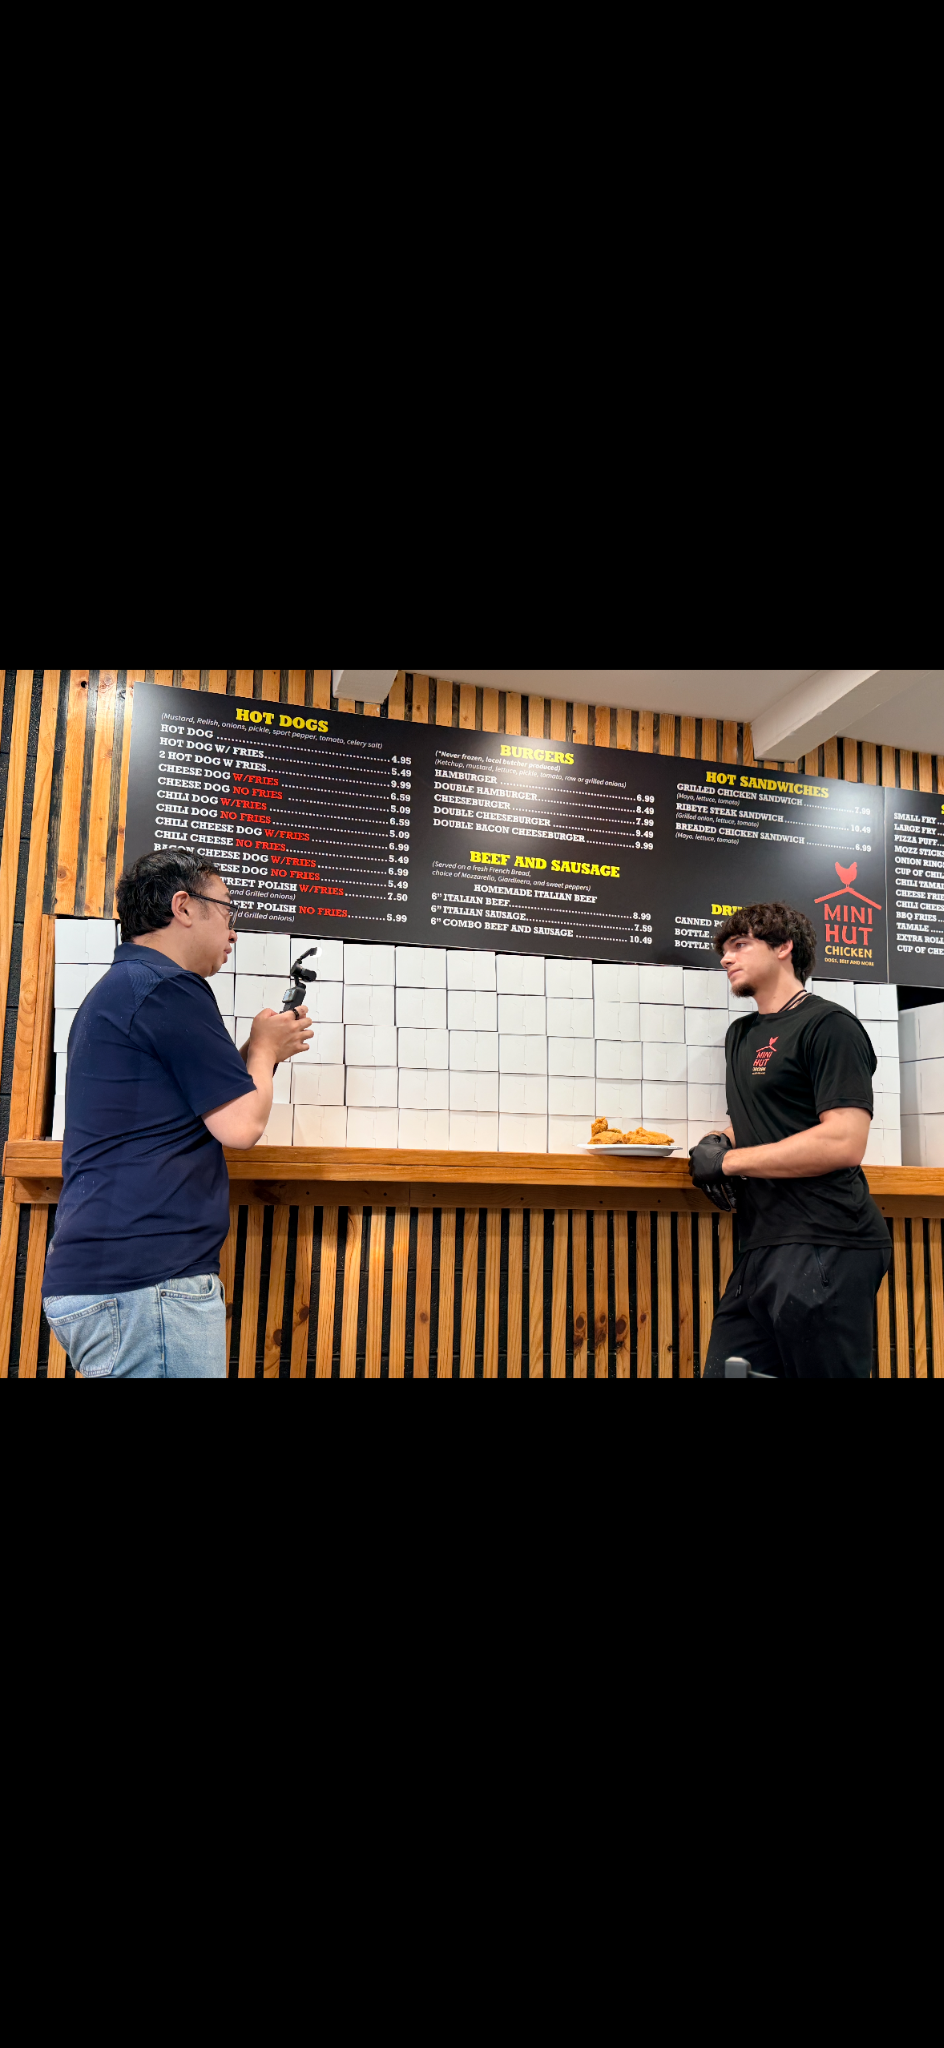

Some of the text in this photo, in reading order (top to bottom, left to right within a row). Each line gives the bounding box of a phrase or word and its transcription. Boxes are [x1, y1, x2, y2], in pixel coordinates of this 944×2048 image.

[162, 713, 195, 724] (Mustard,
[197, 718, 220, 727] Relish,
[222, 722, 246, 731] onions,
[248, 726, 270, 734] pickle,
[292, 732, 317, 740] pepper,
[320, 736, 345, 744] tomato,
[347, 740, 367, 748] celery
[236, 708, 328, 732] HOT DOGS
[161, 724, 411, 764] HOT DOG 4.95
[500, 745, 574, 764] BURGERS
[160, 737, 411, 777] HOT DOG W/ FRIES 5.49
[168, 752, 192, 761] HOT
[195, 755, 220, 765] DOG
[223, 759, 233, 767] W
[236, 760, 268, 772] FRIES
[390, 780, 411, 789] 9.99
[159, 764, 410, 801] CHEESE DOG W/FRIES 6.59
[435, 769, 654, 803] HAMBURGER 6.99
[706, 772, 829, 798] HOT SANDWICHES
[158, 777, 410, 814] CHEESE DOG NO FRIES 5.09
[434, 782, 654, 814] DOUBLE HAMBURGER 8.49
[677, 783, 715, 794] GRILLED
[717, 788, 757, 799] CHICKEN
[759, 794, 802, 805] SANDWICH
[157, 790, 410, 826] CHILI DOG W/FRIES 6.59
[434, 794, 654, 826] CHEESEBURGER 7.99
[676, 803, 708, 813] RIBEYE
[710, 807, 737, 817] STEAK
[739, 811, 784, 822] SANDWICH
[894, 813, 937, 824] SMALL FRY
[156, 804, 410, 839] CHILI DOG NO FRIES 5.09
[434, 806, 653, 838] DOUBLE CHEESEBURGER 9.49
[894, 824, 937, 835] LARGE FRY
[156, 817, 409, 851] CHILI CHEESE DOG W/FRIES 6.99
[433, 819, 653, 850] DOUBLE BACON CHEESEBURGER 9.99
[676, 823, 716, 833] BREADED
[719, 828, 759, 838] CHICKEN
[760, 832, 804, 843] SANDWICH
[895, 835, 939, 846] PIZZA PUFF
[155, 830, 409, 864] CHILI CHEESE NO FRIES 5.49
[895, 845, 918, 854] MOZZ
[197, 848, 408, 876] CHEESE DOG W/FRIES 6.99
[470, 851, 620, 877] BEEF AND SAUSAGE
[895, 856, 922, 865] ONION
[242, 866, 408, 889] DOG NO FRIES 5.49
[896, 878, 918, 887] CHILI
[912, 869, 924, 877] OF
[258, 880, 408, 901] POLISH W/FRIES 7.50
[270, 893, 296, 901] onions)
[474, 884, 597, 903] HOMEMADE ITALIAN BEEF
[896, 889, 926, 898] CHEESE
[257, 902, 296, 913] POLISH
[299, 906, 315, 914] NO
[318, 908, 348, 917] FRIES
[386, 914, 407, 922] 5.99
[444, 894, 483, 904] ITALIAN
[486, 898, 510, 907] BEEF
[632, 912, 651, 920] 8.99
[825, 904, 872, 924] MINI
[896, 900, 918, 909] CHILI
[443, 906, 483, 916] ITALIAN
[485, 910, 527, 921] SAUSAGE
[634, 924, 652, 932] 7.59
[675, 917, 712, 926] CANNED
[896, 911, 937, 922] BBQ FRIES
[896, 922, 930, 932] TAMALE
[443, 919, 482, 928] COMBO
[485, 922, 509, 931] BEEF
[510, 924, 531, 933] AND
[534, 927, 573, 937] SAUSAGE
[630, 936, 652, 944] 10.49
[675, 928, 710, 938] BOTTLE
[826, 924, 873, 945] HUT
[897, 933, 923, 942] EXTRA
[675, 940, 710, 949] BOTTLE
[825, 945, 872, 958] CHICKEN
[915, 946, 926, 954] OF
